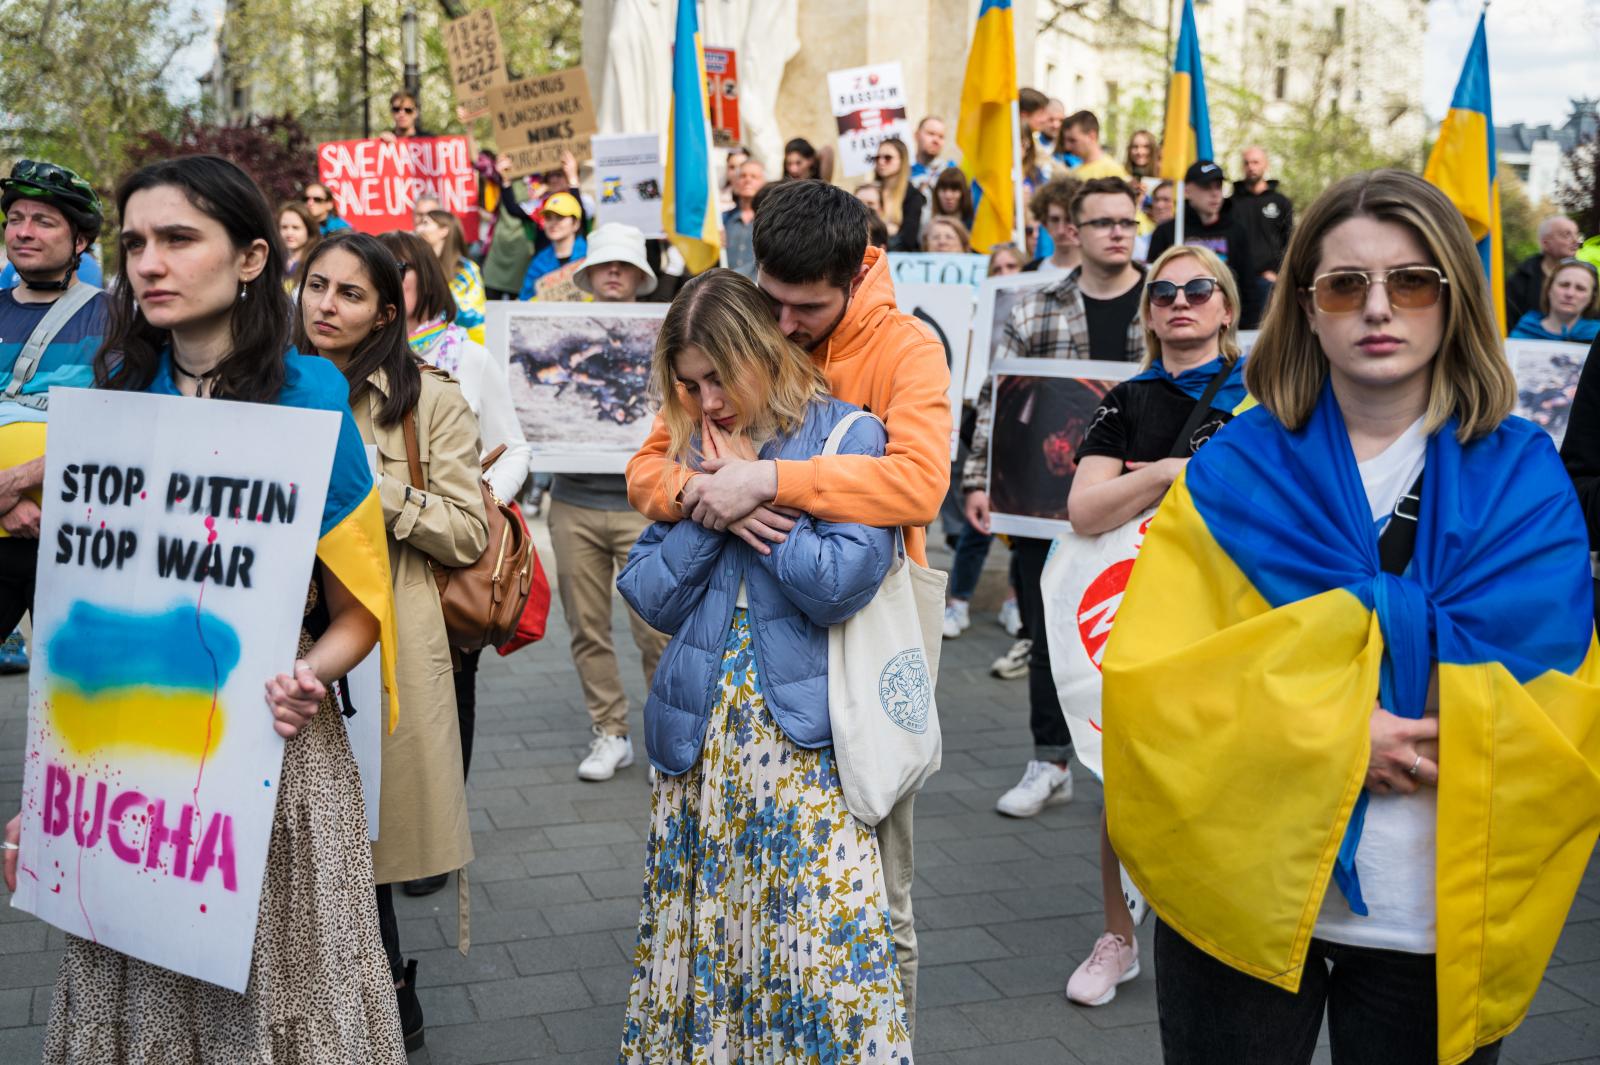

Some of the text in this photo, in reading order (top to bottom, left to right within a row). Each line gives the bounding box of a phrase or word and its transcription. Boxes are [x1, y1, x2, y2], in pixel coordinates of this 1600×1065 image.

[457, 54, 500, 85] 2022
[322, 139, 473, 179] SAVE MARIUPOL
[325, 174, 476, 216] SAVE UKRAINE
[61, 464, 145, 506] STOP
[56, 523, 256, 588] STOP WAR
[43, 764, 238, 892] BUCHA
